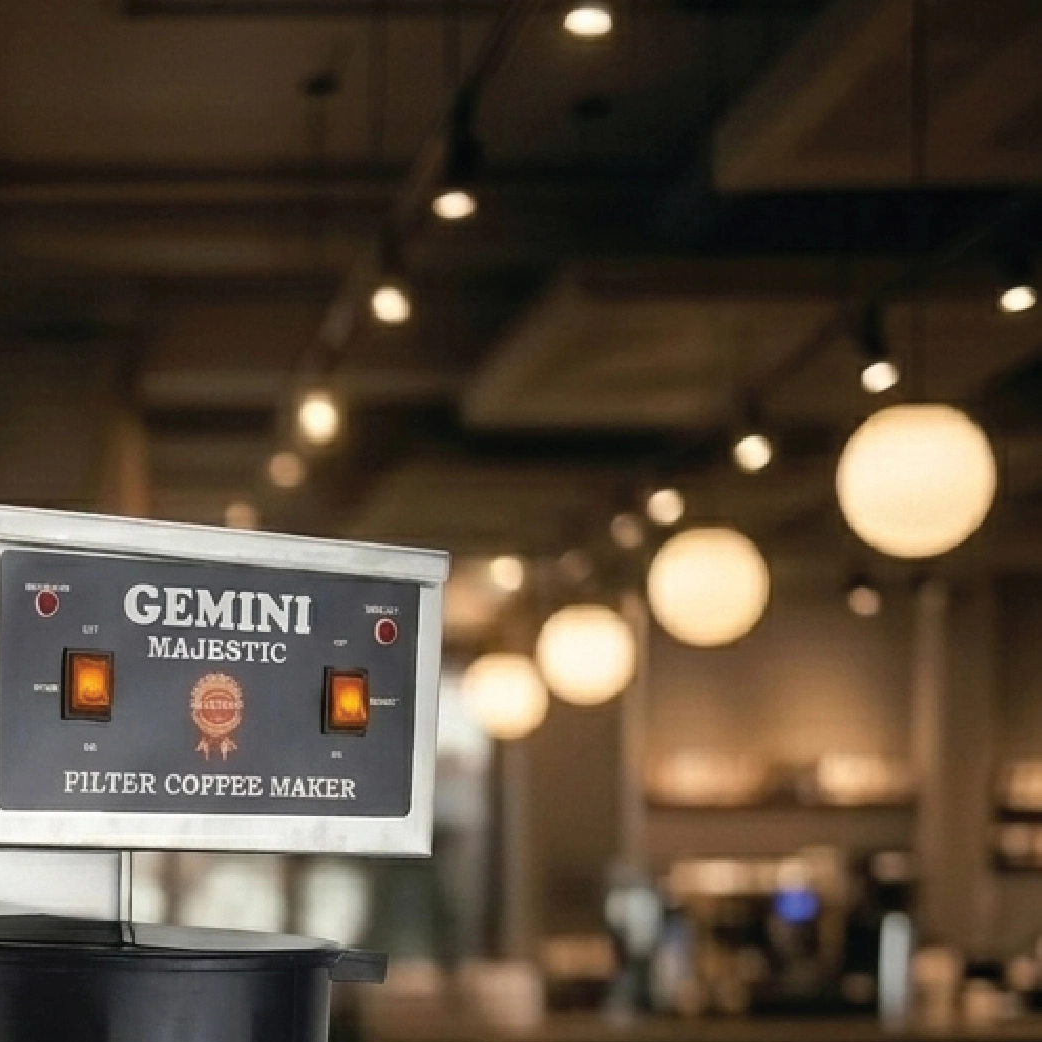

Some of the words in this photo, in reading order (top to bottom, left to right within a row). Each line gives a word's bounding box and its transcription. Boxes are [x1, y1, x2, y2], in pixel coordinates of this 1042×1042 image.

[124, 584, 312, 635] GEMINI
[147, 636, 287, 664] MAJESTIC
[269, 775, 356, 800] MAKER
